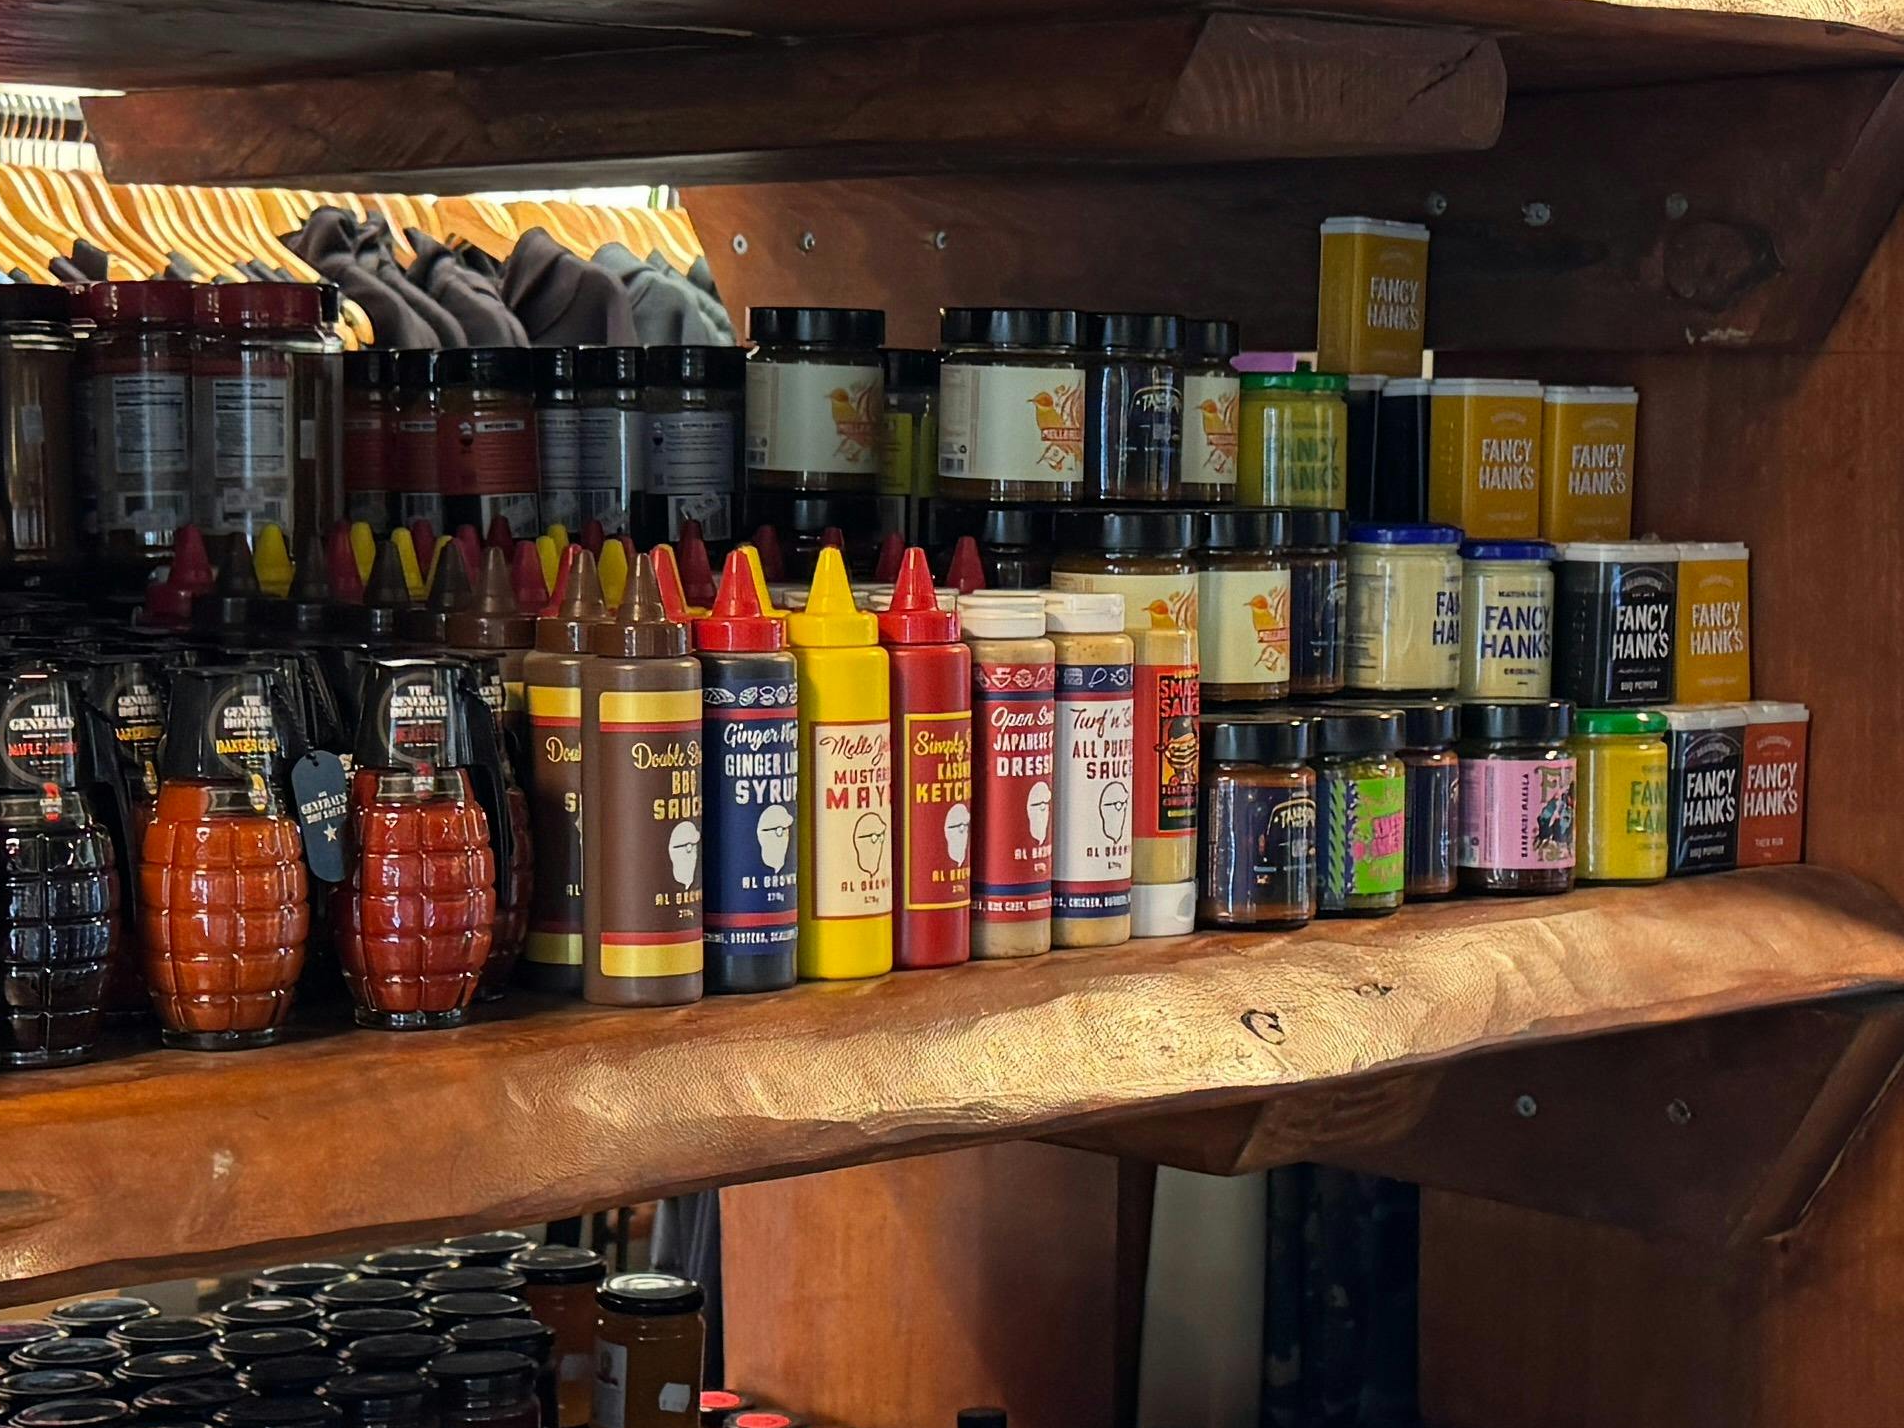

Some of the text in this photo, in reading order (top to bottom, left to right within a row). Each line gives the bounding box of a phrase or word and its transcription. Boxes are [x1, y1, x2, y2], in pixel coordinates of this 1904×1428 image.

[1370, 276, 1419, 304] FANCY
[1482, 438, 1532, 463] FANCY
[1572, 444, 1626, 469] FANCY
[1616, 604, 1669, 633] FANCY
[1691, 601, 1740, 629] FANCY
[1612, 632, 1669, 660] HANK'S
[408, 684, 432, 696] THE
[31, 704, 60, 718] THE
[724, 721, 779, 752] Ginger
[1072, 740, 1098, 759] ALL
[632, 741, 687, 770] Double
[725, 751, 782, 778] GINGER
[1686, 769, 1736, 798] FANCY
[1747, 762, 1798, 789] FANCY
[735, 776, 798, 805] SYRU
